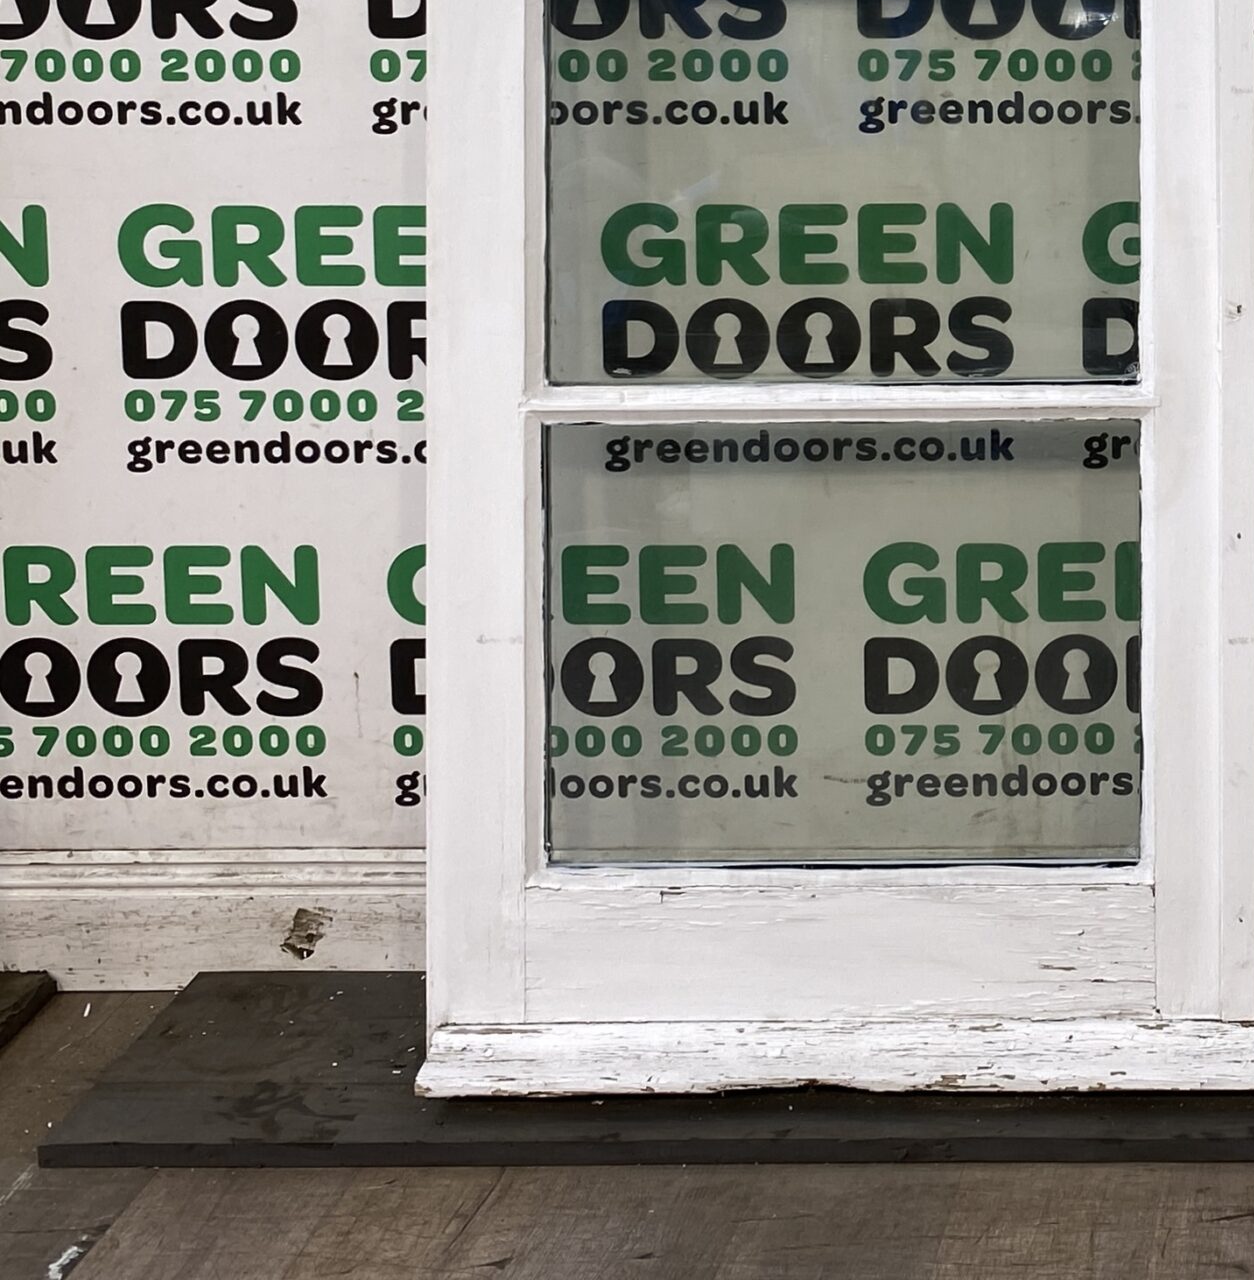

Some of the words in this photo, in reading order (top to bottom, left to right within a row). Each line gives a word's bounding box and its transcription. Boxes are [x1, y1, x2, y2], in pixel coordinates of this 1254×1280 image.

[0, 49, 141, 82] 7000
[161, 49, 300, 82] 2000
[648, 49, 788, 82] 2000
[858, 49, 955, 81] 075
[975, 49, 1112, 82] 7000
[601, 203, 1013, 287] GREEN
[602, 296, 1014, 380] DOORS
[125, 390, 220, 421] 075
[239, 390, 377, 421] 7000
[605, 429, 1014, 472] greendoors.co.uk
[3, 545, 320, 626] REEN
[551, 636, 796, 717] ORS
[864, 634, 1138, 715] DOO
[32, 725, 170, 757] 7000
[189, 725, 326, 757] 2000
[661, 725, 798, 757] 2000
[865, 725, 960, 757] 075
[979, 723, 1114, 755] 7000
[551, 766, 798, 798] oors.co.uk
